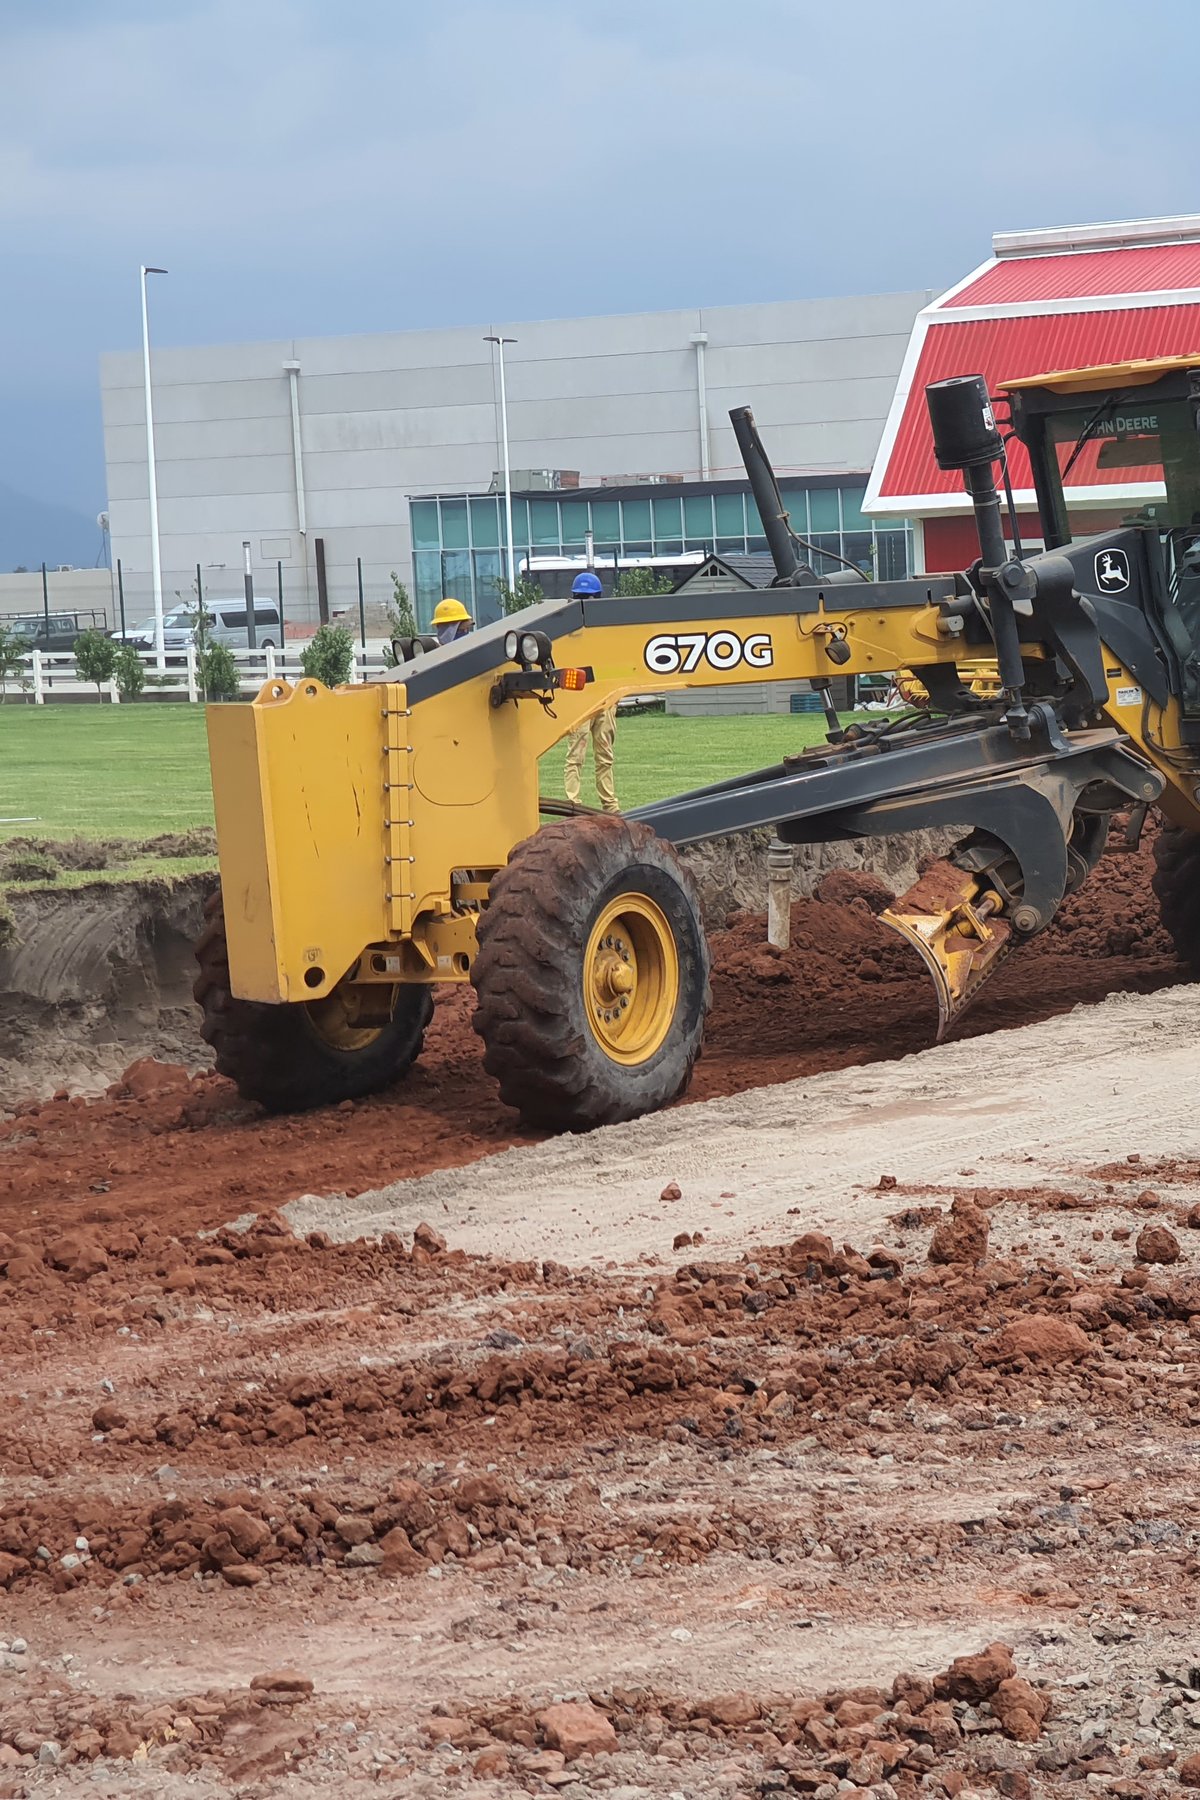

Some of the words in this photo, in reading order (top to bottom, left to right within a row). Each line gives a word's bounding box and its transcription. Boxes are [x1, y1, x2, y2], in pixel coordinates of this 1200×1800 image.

[1083, 420, 1114, 435] HN
[1116, 416, 1159, 432] DEERE
[644, 630, 773, 674] 670G
